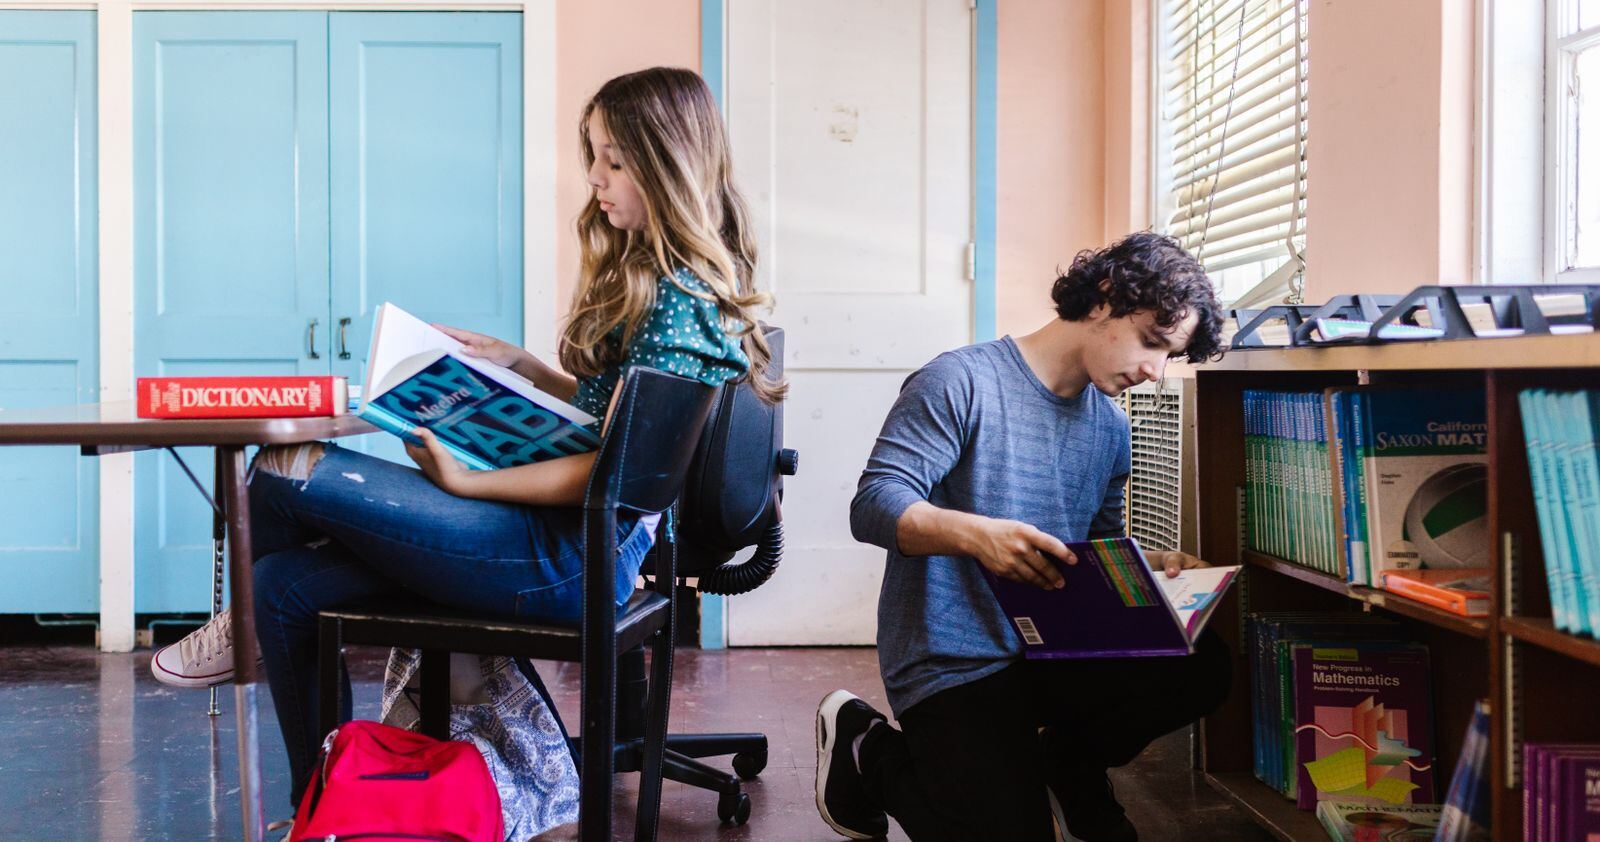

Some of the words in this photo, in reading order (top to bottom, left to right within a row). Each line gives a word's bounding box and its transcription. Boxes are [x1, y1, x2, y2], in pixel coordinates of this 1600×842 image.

[182, 388, 308, 407] DICTIONARY
[415, 385, 472, 423] Algebra
[1377, 432, 1433, 450] SAXON
[1313, 672, 1400, 686] Mathematics
